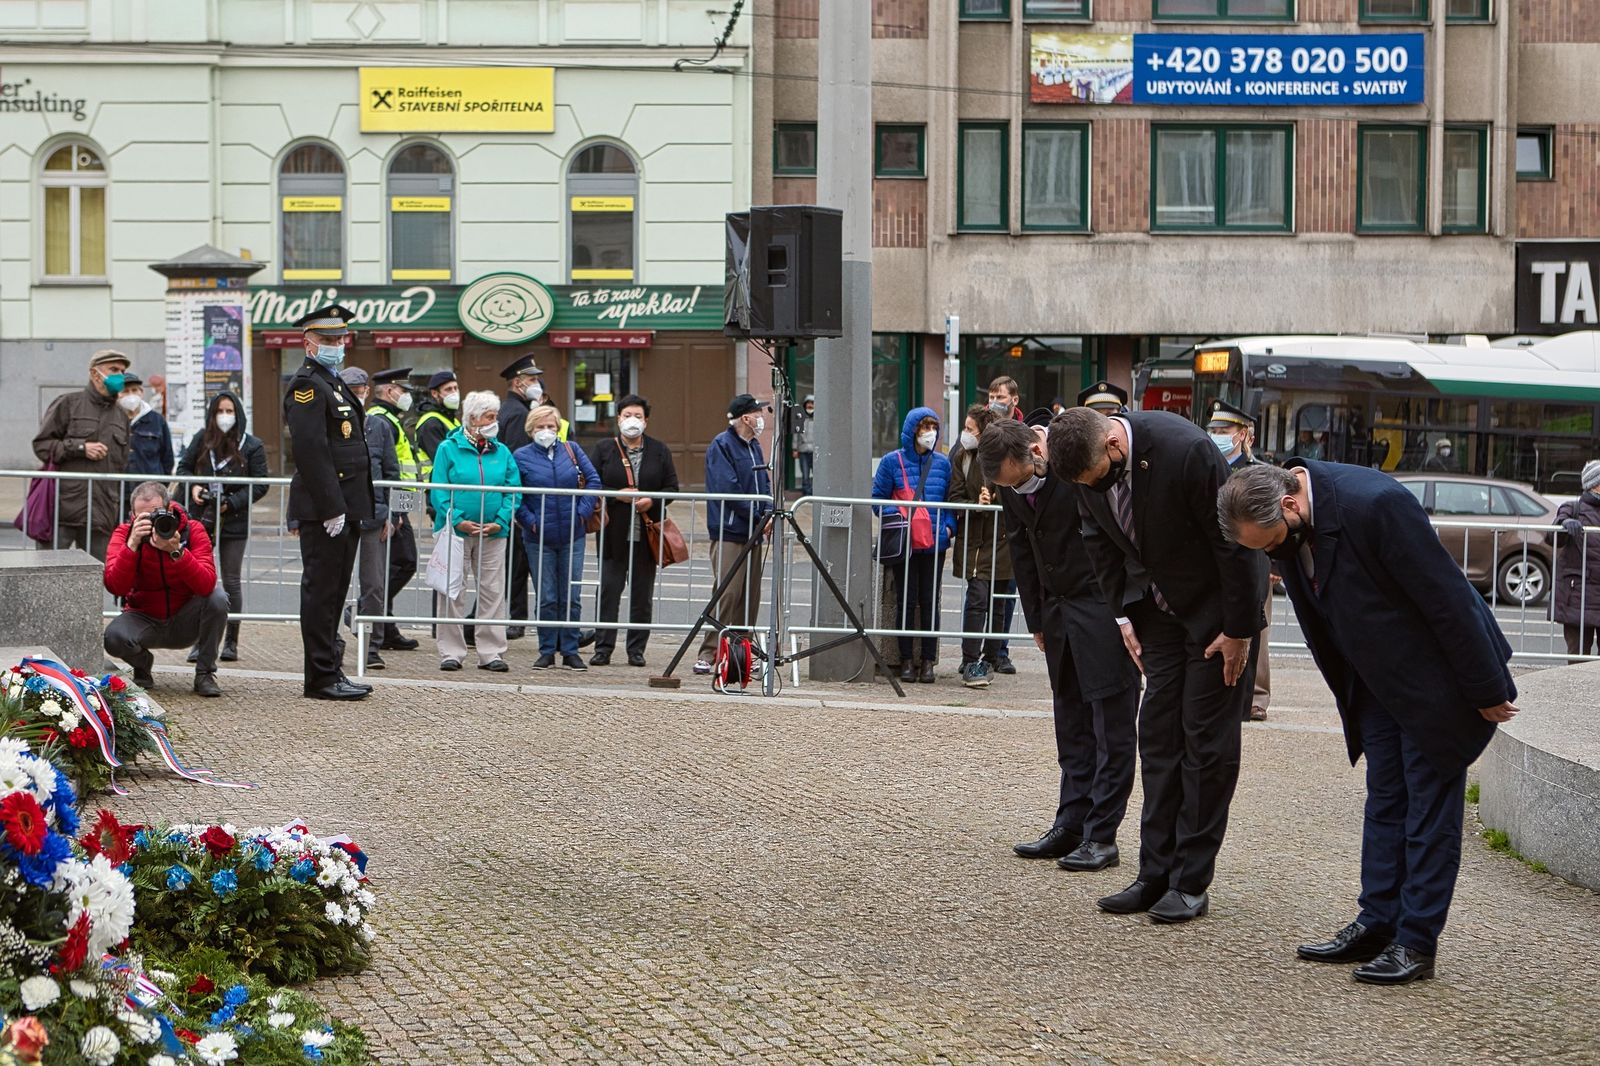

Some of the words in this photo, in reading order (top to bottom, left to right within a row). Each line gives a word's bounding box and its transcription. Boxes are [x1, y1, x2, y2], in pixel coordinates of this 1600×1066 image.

[1147, 47, 1221, 73] +420
[1230, 47, 1283, 74] 378
[1291, 47, 1346, 74] 020
[1355, 46, 1408, 74] 500
[398, 87, 462, 98] Raiffeisen
[1146, 78, 1232, 95] UBYTOVÁNÍ
[1245, 80, 1339, 96] KONFERENCE
[1353, 80, 1407, 95] SVATBY
[398, 99, 460, 112] STAVEBNÍ
[463, 99, 544, 112] SPOŘITELNA
[569, 290, 591, 307] Ta
[593, 288, 611, 304] to
[597, 286, 702, 329] upekla!
